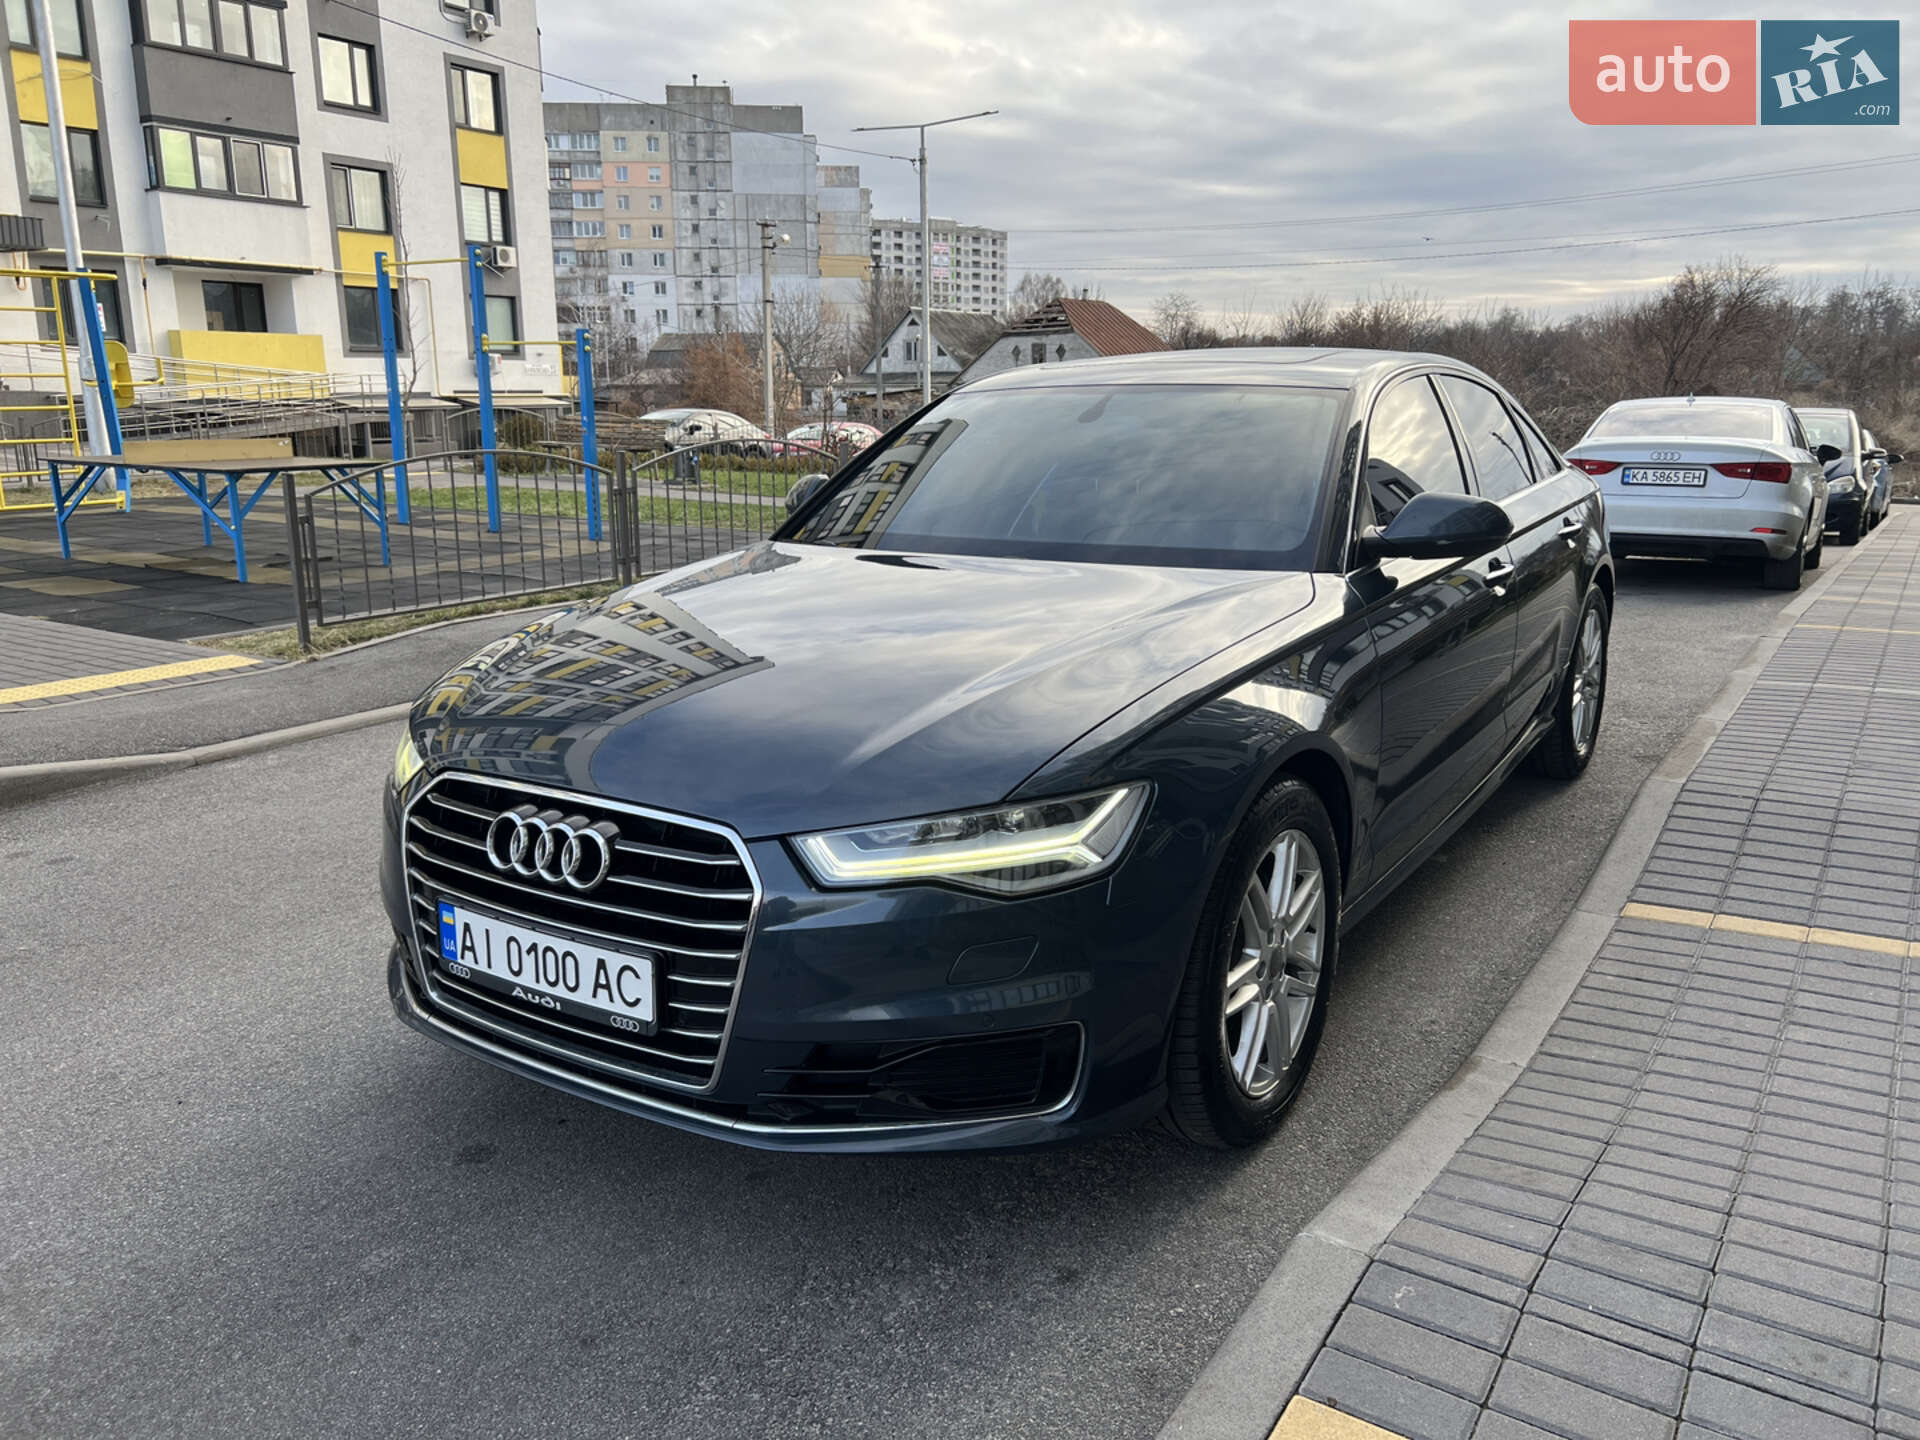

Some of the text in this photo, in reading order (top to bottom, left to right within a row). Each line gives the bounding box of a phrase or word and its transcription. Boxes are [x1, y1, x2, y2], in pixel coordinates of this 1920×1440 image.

[1632, 471, 1702, 483] KA 5865 EH
[443, 937, 457, 952] UA
[460, 921, 642, 1008] AI 0100 AC
[511, 986, 561, 1011] Audi
